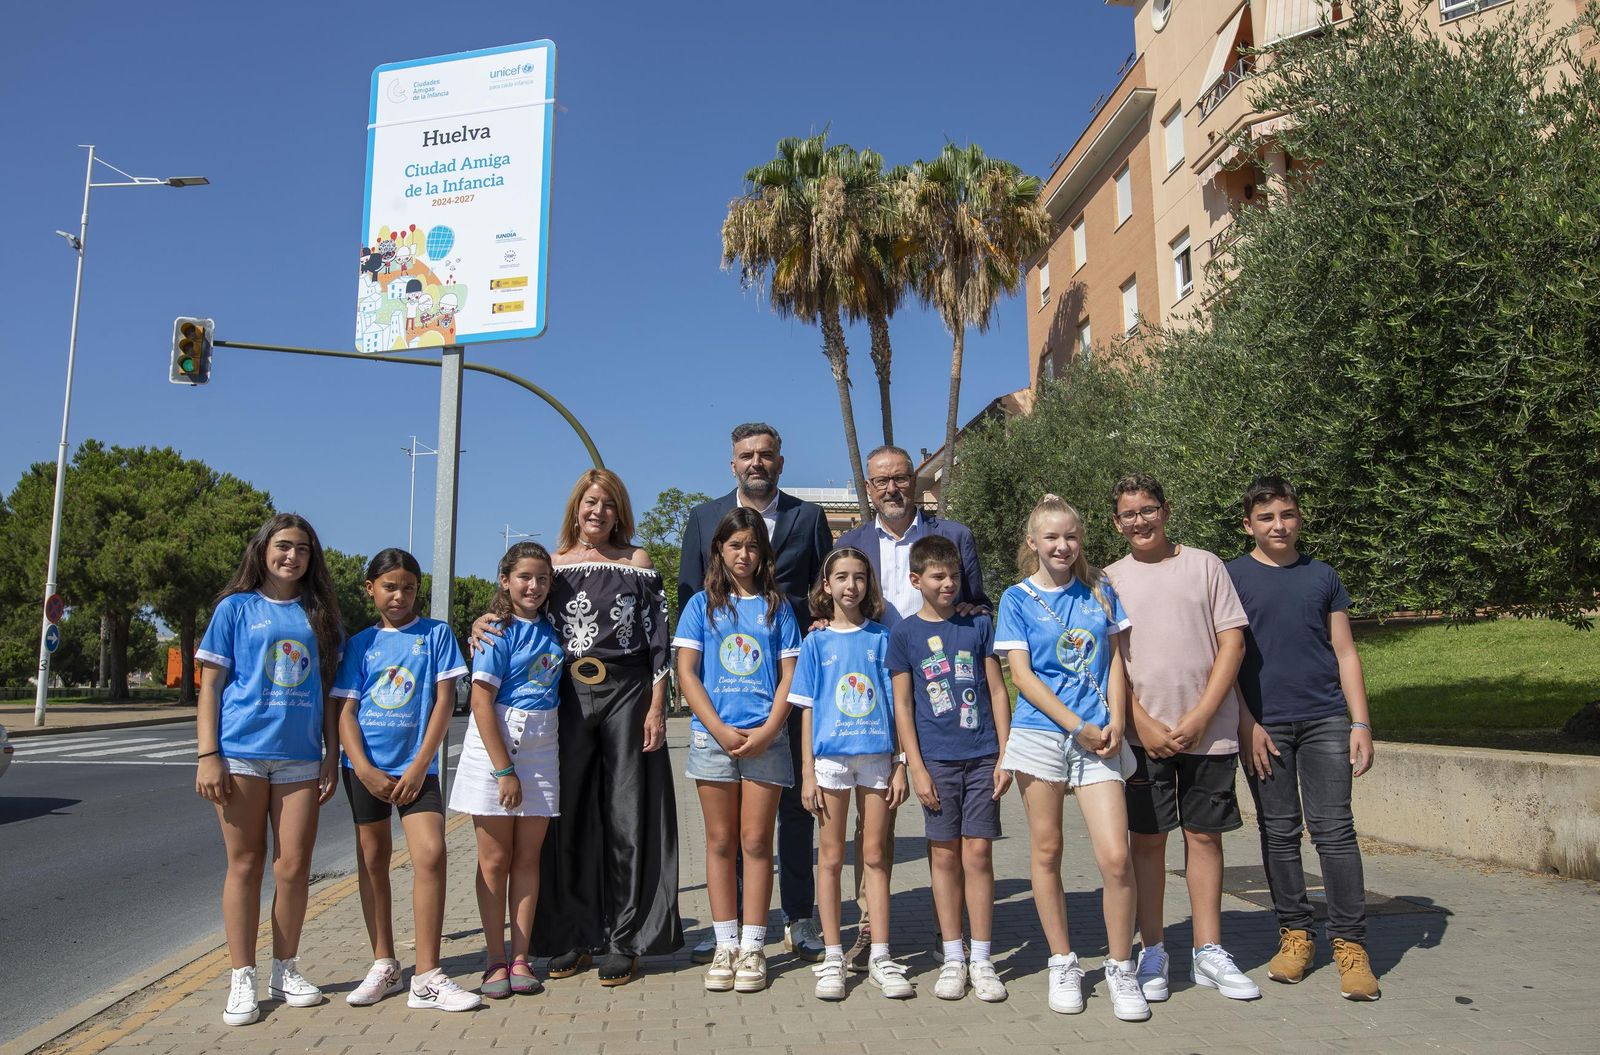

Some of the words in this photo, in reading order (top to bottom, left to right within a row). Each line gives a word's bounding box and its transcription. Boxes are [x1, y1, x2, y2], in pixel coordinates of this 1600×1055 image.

[489, 64, 522, 79] unicef
[412, 86, 436, 95] Amigas
[413, 79, 441, 88] Ciudades
[422, 125, 492, 148] Huelva
[404, 158, 457, 178] Ciudad
[460, 153, 511, 171] Amiga
[404, 184, 422, 198] de
[425, 181, 439, 196] la
[442, 173, 505, 194] Infancia
[431, 194, 475, 207] 2024-2027
